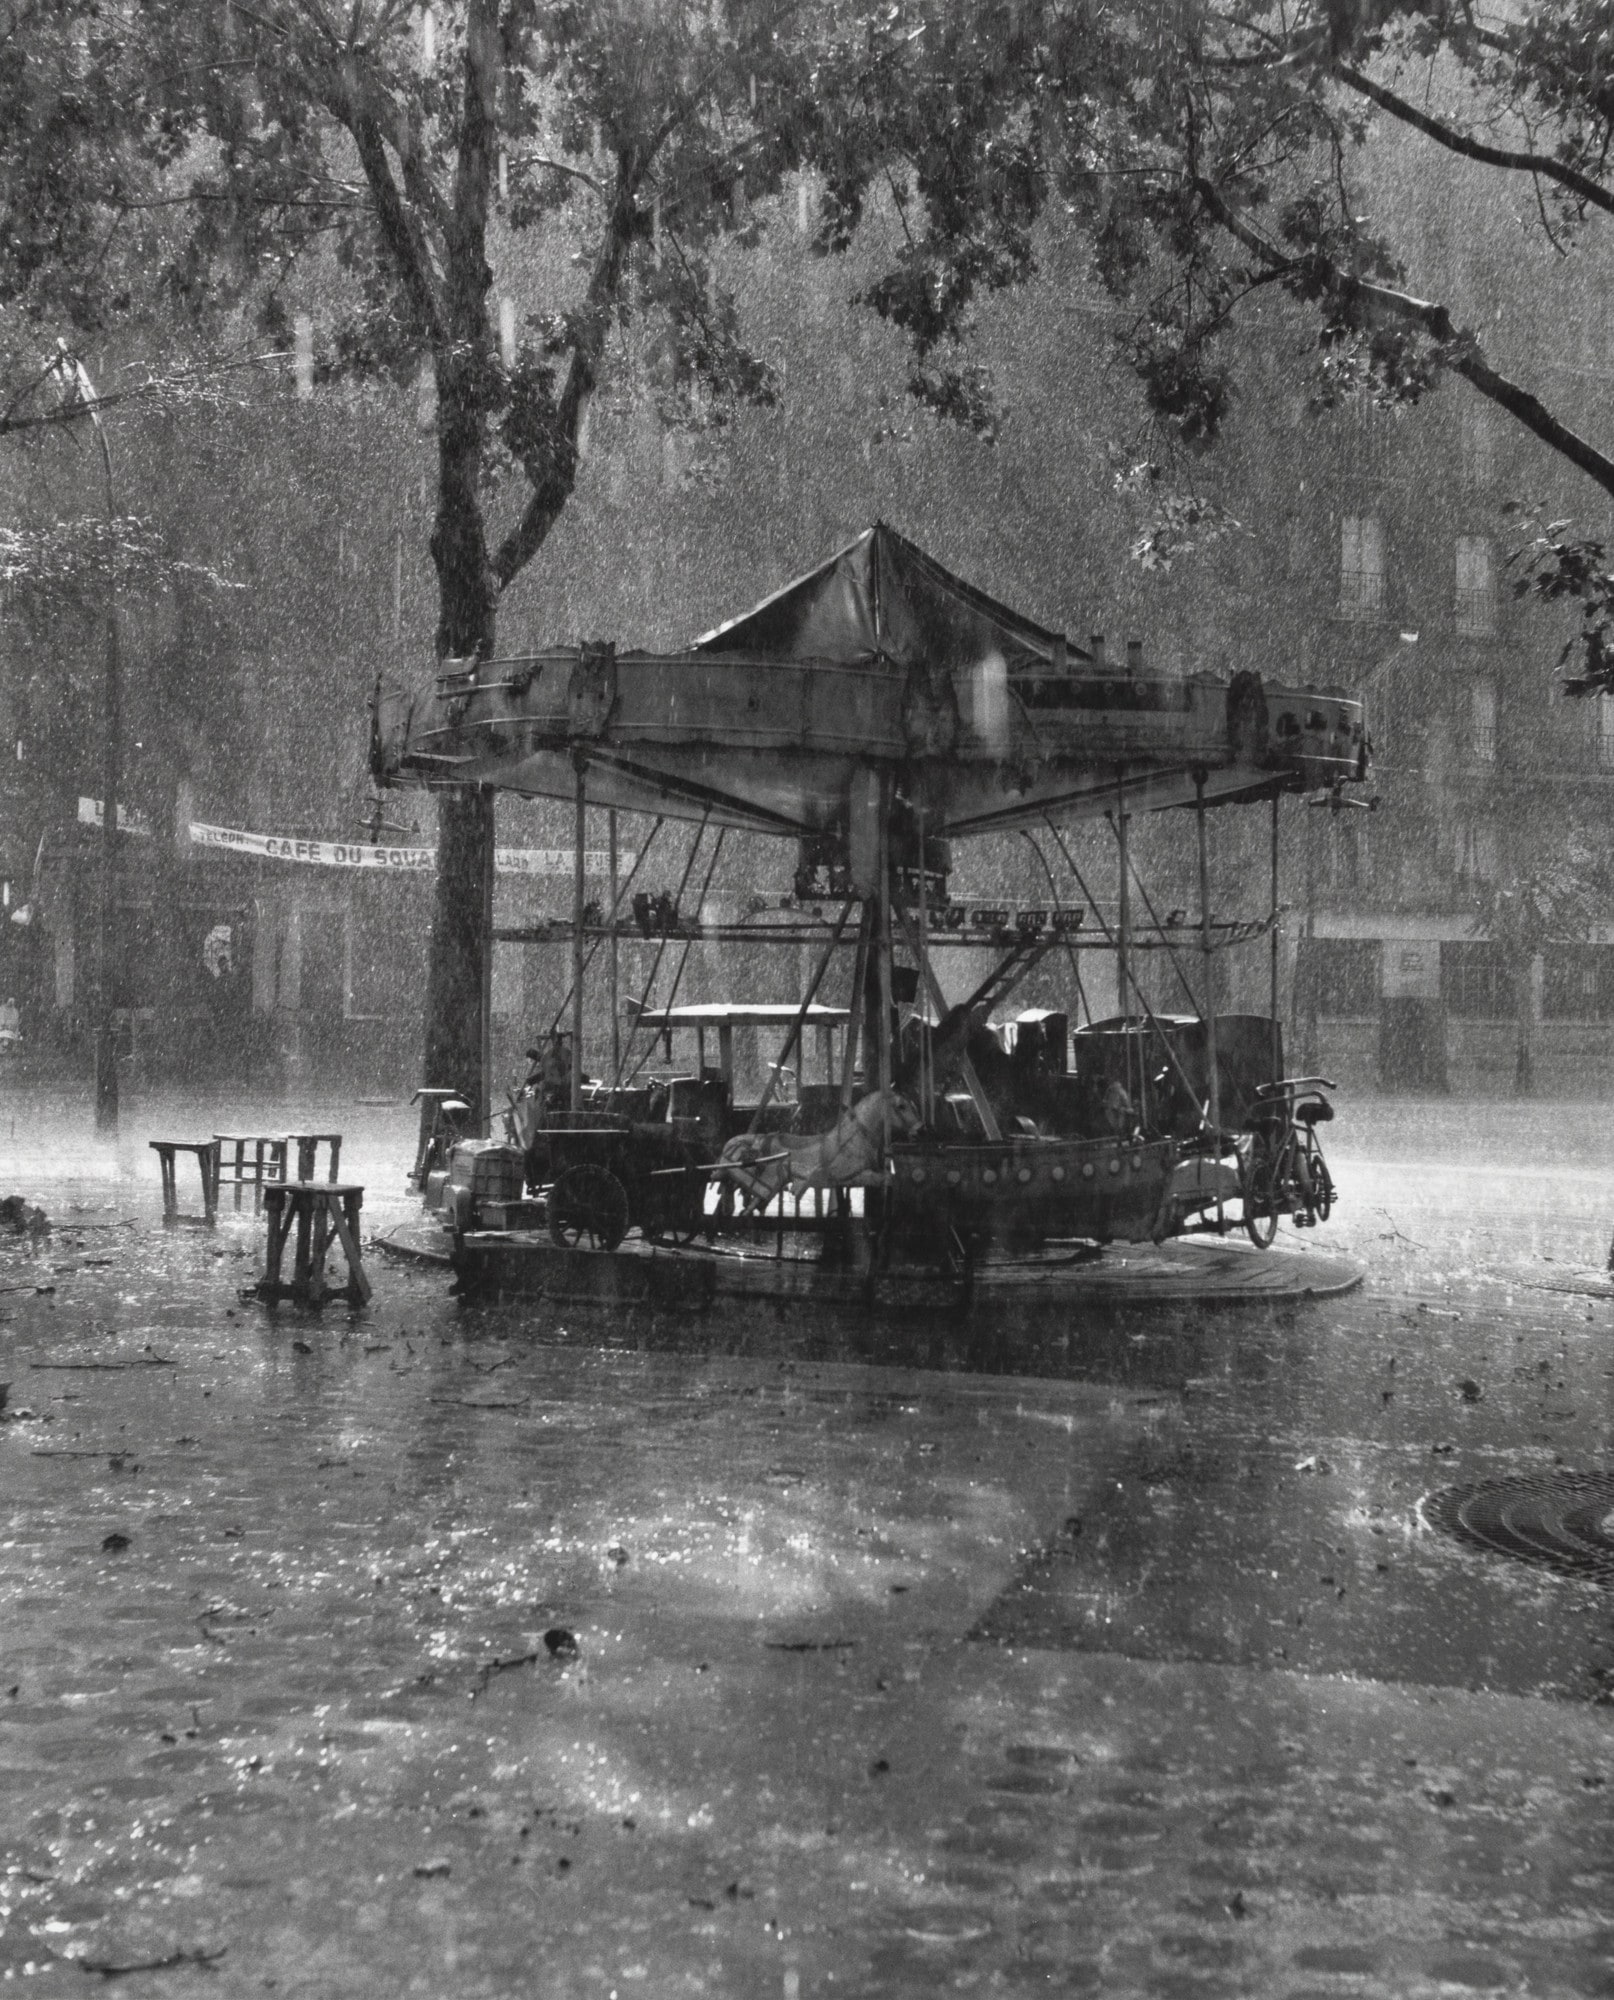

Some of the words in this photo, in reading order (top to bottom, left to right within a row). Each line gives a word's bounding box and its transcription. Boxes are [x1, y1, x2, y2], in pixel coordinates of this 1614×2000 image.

[333, 845, 362, 864] DU
[374, 848, 435, 867] SQUA
[497, 854, 529, 868] LARD
